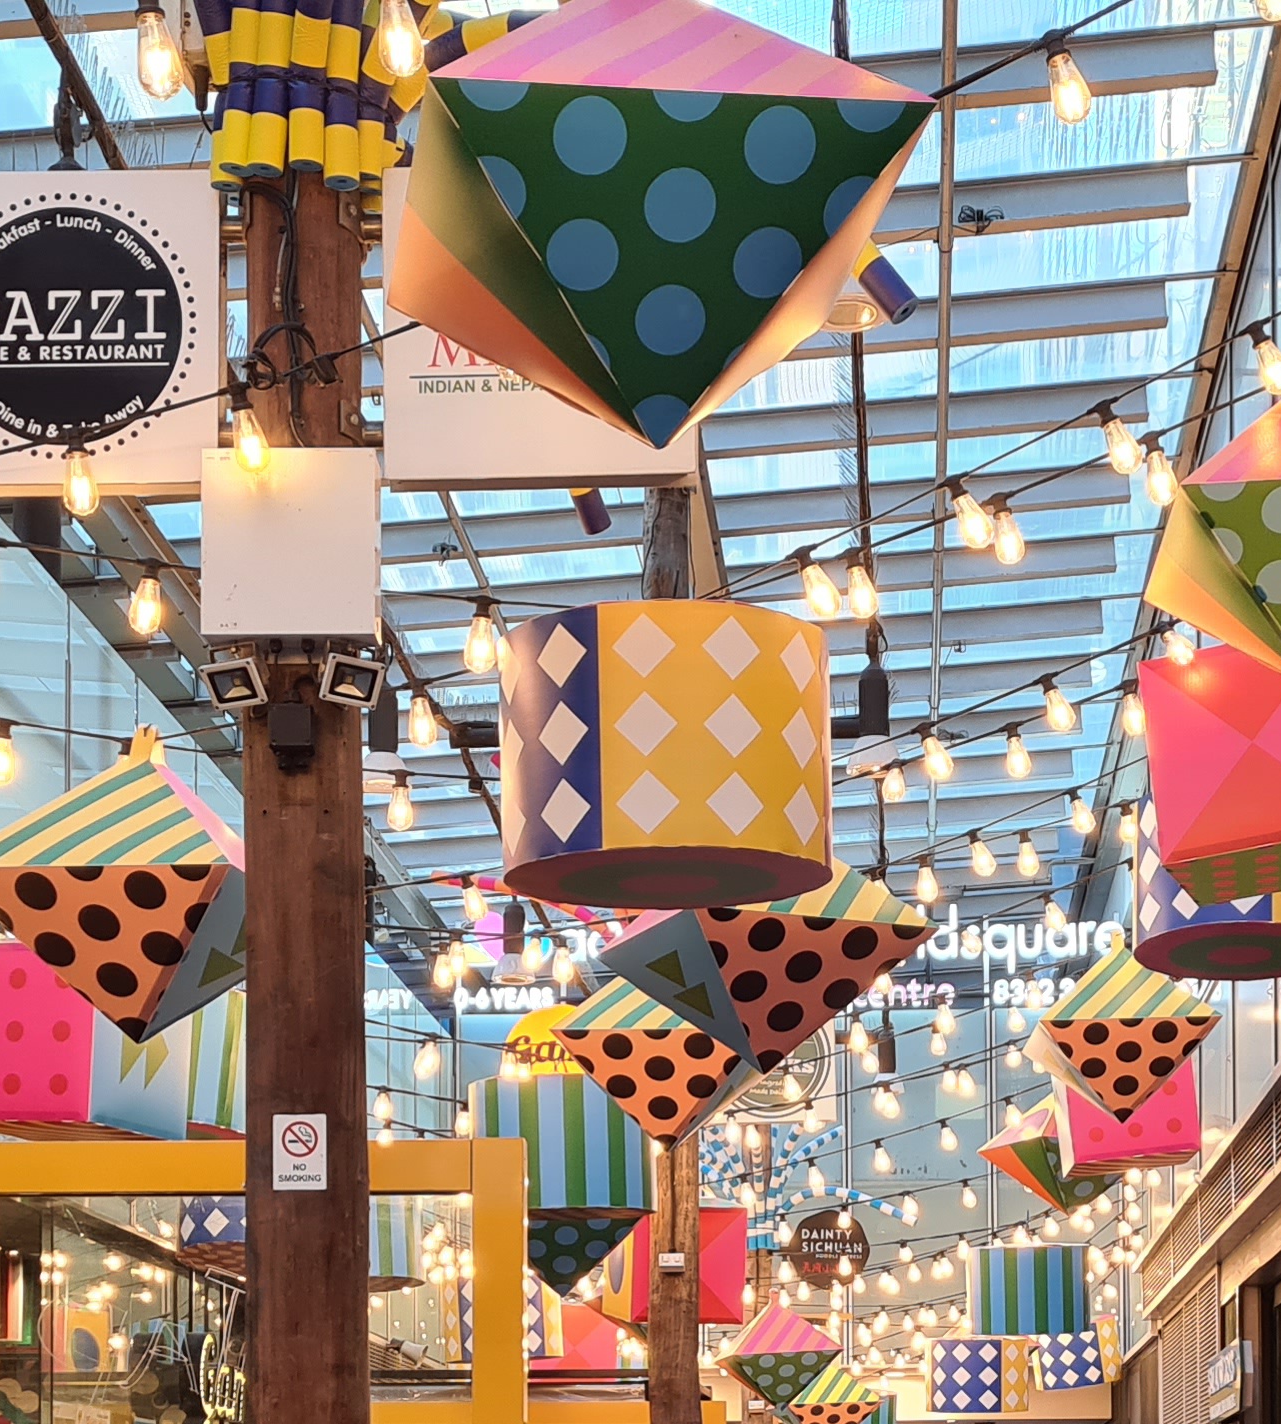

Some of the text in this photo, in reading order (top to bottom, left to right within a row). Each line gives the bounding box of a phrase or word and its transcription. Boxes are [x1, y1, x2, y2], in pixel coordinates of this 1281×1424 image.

[56, 213, 102, 233] Lunch
[114, 228, 157, 272] Dinner
[17, 346, 31, 361] &
[39, 344, 165, 361] RESTAURANT
[419, 379, 543, 394] INDIAN & NEPA
[26, 420, 42, 437] in
[45, 423, 59, 438] &
[491, 986, 555, 1010] YEARS
[993, 978, 1054, 1006] 832
[292, 1163, 307, 1171] NO
[278, 1174, 322, 1183] SMOKING
[801, 1228, 852, 1240] DAINTY
[802, 1242, 863, 1253] SICHUAN
